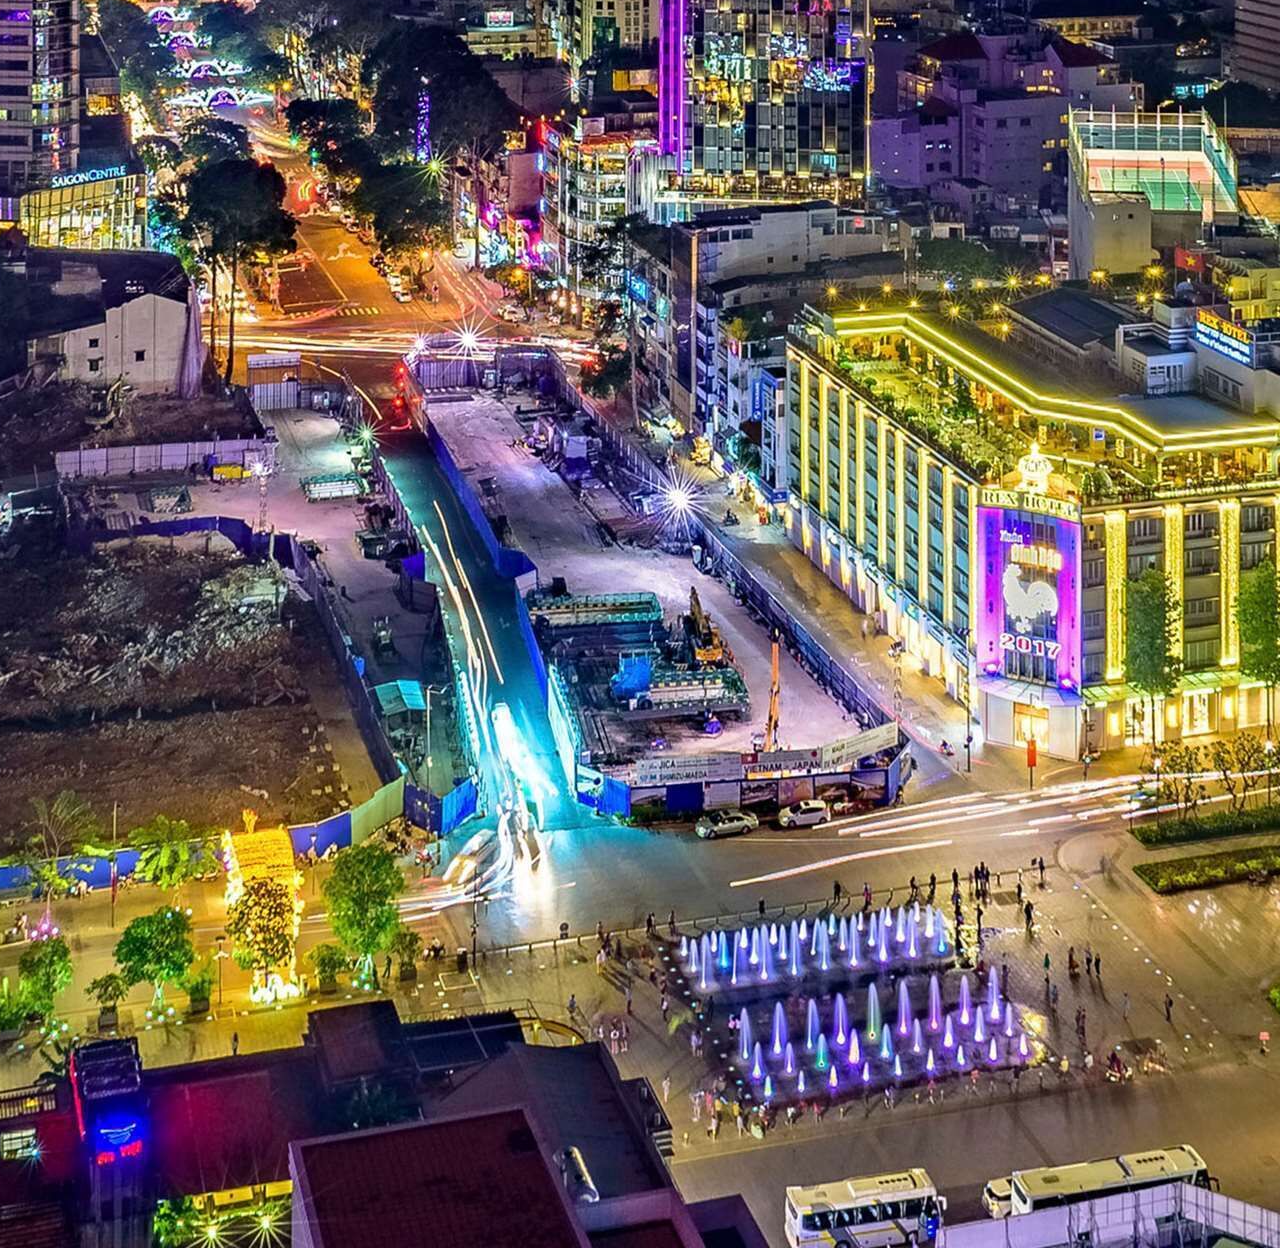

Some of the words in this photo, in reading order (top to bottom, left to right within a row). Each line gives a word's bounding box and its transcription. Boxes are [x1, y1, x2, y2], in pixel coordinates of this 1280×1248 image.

[983, 491, 1018, 506] REX
[1024, 494, 1078, 520] HOTEL
[999, 633, 1062, 660] 2017
[659, 759, 676, 769] JICA
[743, 762, 782, 773] VIETNAM
[793, 760, 821, 770] JAPAN
